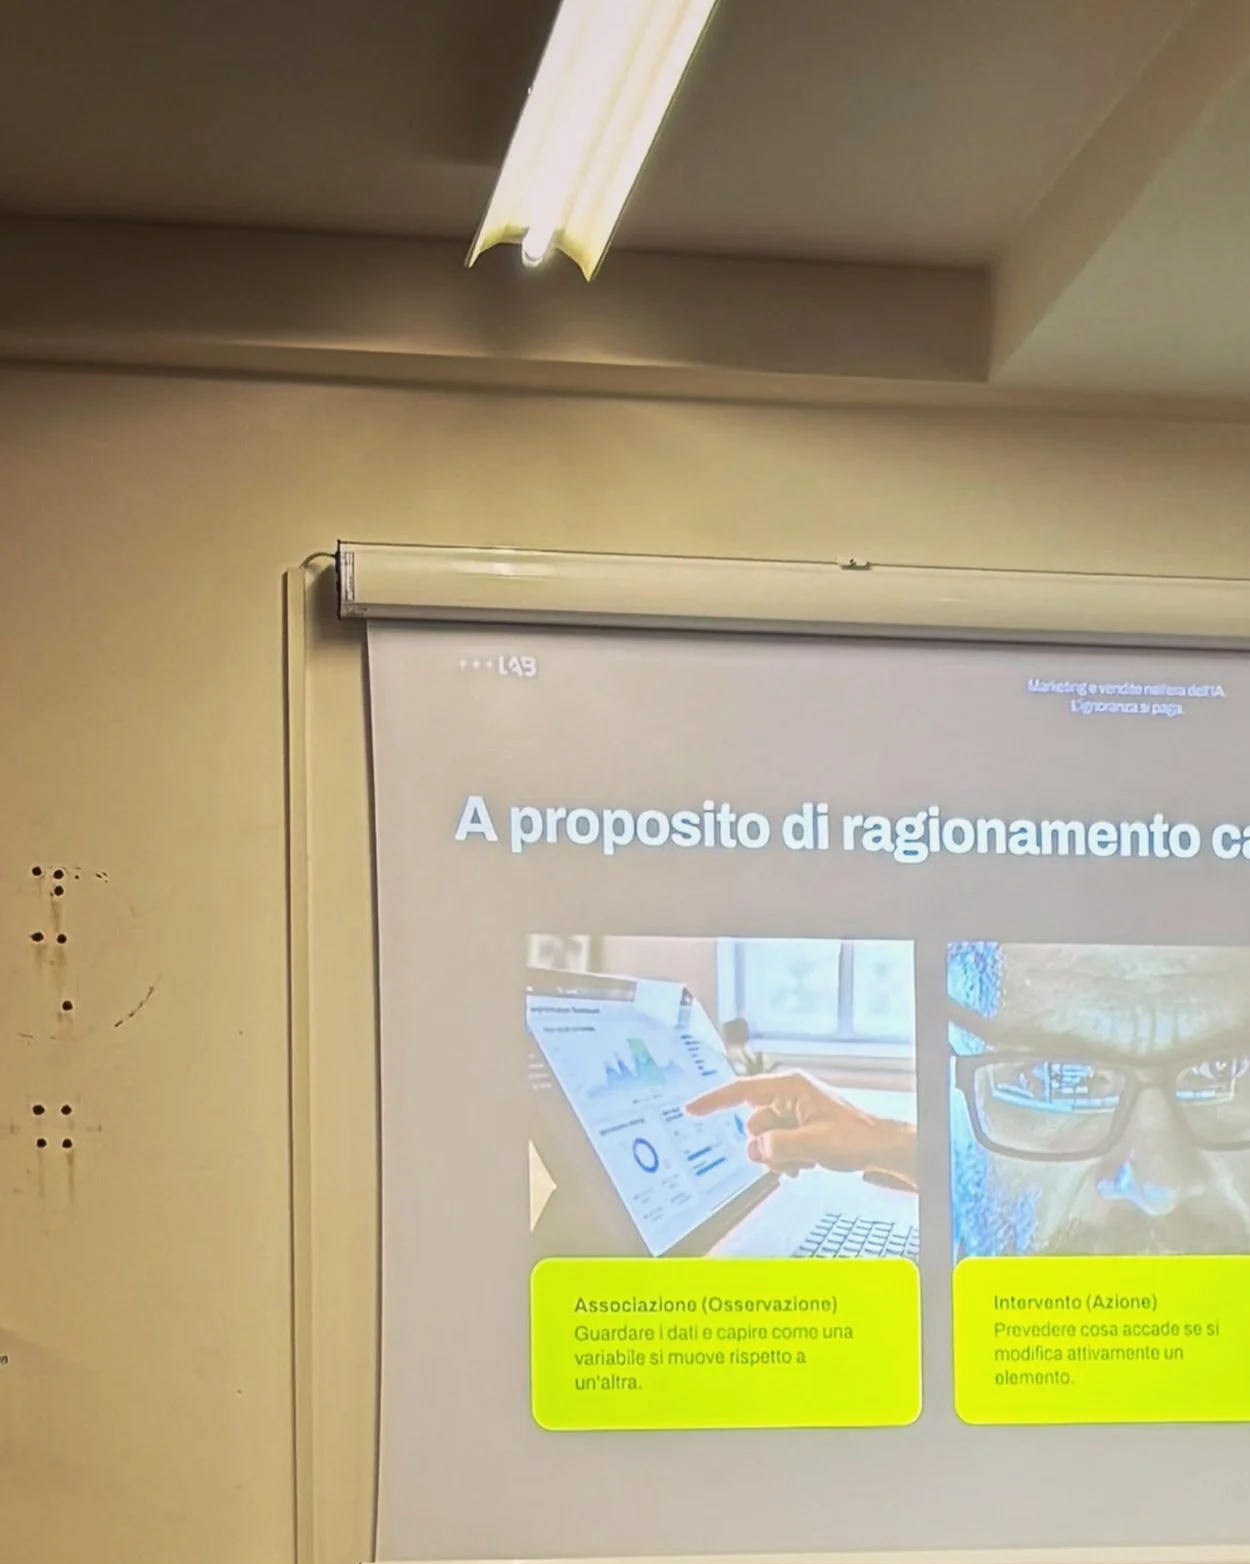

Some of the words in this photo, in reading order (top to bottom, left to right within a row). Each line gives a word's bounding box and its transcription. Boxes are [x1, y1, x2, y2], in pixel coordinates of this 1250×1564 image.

[1027, 679, 1088, 696] Marketing
[455, 795, 498, 842] A
[511, 800, 771, 855] proposito
[782, 803, 829, 850] di
[842, 806, 1200, 863] ragionamento
[574, 1296, 697, 1314] Associazione
[701, 1295, 838, 1315] (Osservazione)
[994, 1294, 1082, 1311] Intervento
[1086, 1293, 1157, 1312] (Azione)
[574, 1324, 655, 1342] Guardare
[667, 1324, 699, 1341] dati
[702, 1327, 713, 1341] e
[716, 1324, 768, 1345] capire
[771, 1326, 819, 1341] come
[822, 1326, 854, 1340] una
[994, 1321, 1076, 1338] Prevedere
[1080, 1324, 1118, 1337] cosa
[1122, 1320, 1180, 1337] accade
[1184, 1323, 1202, 1336] se
[1206, 1319, 1220, 1336] si
[574, 1348, 646, 1367] variabile
[649, 1349, 664, 1366] si
[668, 1351, 725, 1366] muove
[729, 1348, 792, 1369] rispetto
[795, 1351, 807, 1365] a
[994, 1345, 1062, 1362] modifica
[1067, 1345, 1160, 1361] attivamente
[1164, 1347, 1184, 1361] un
[574, 1373, 643, 1391] un'altra.
[994, 1369, 1075, 1386] elemento.
